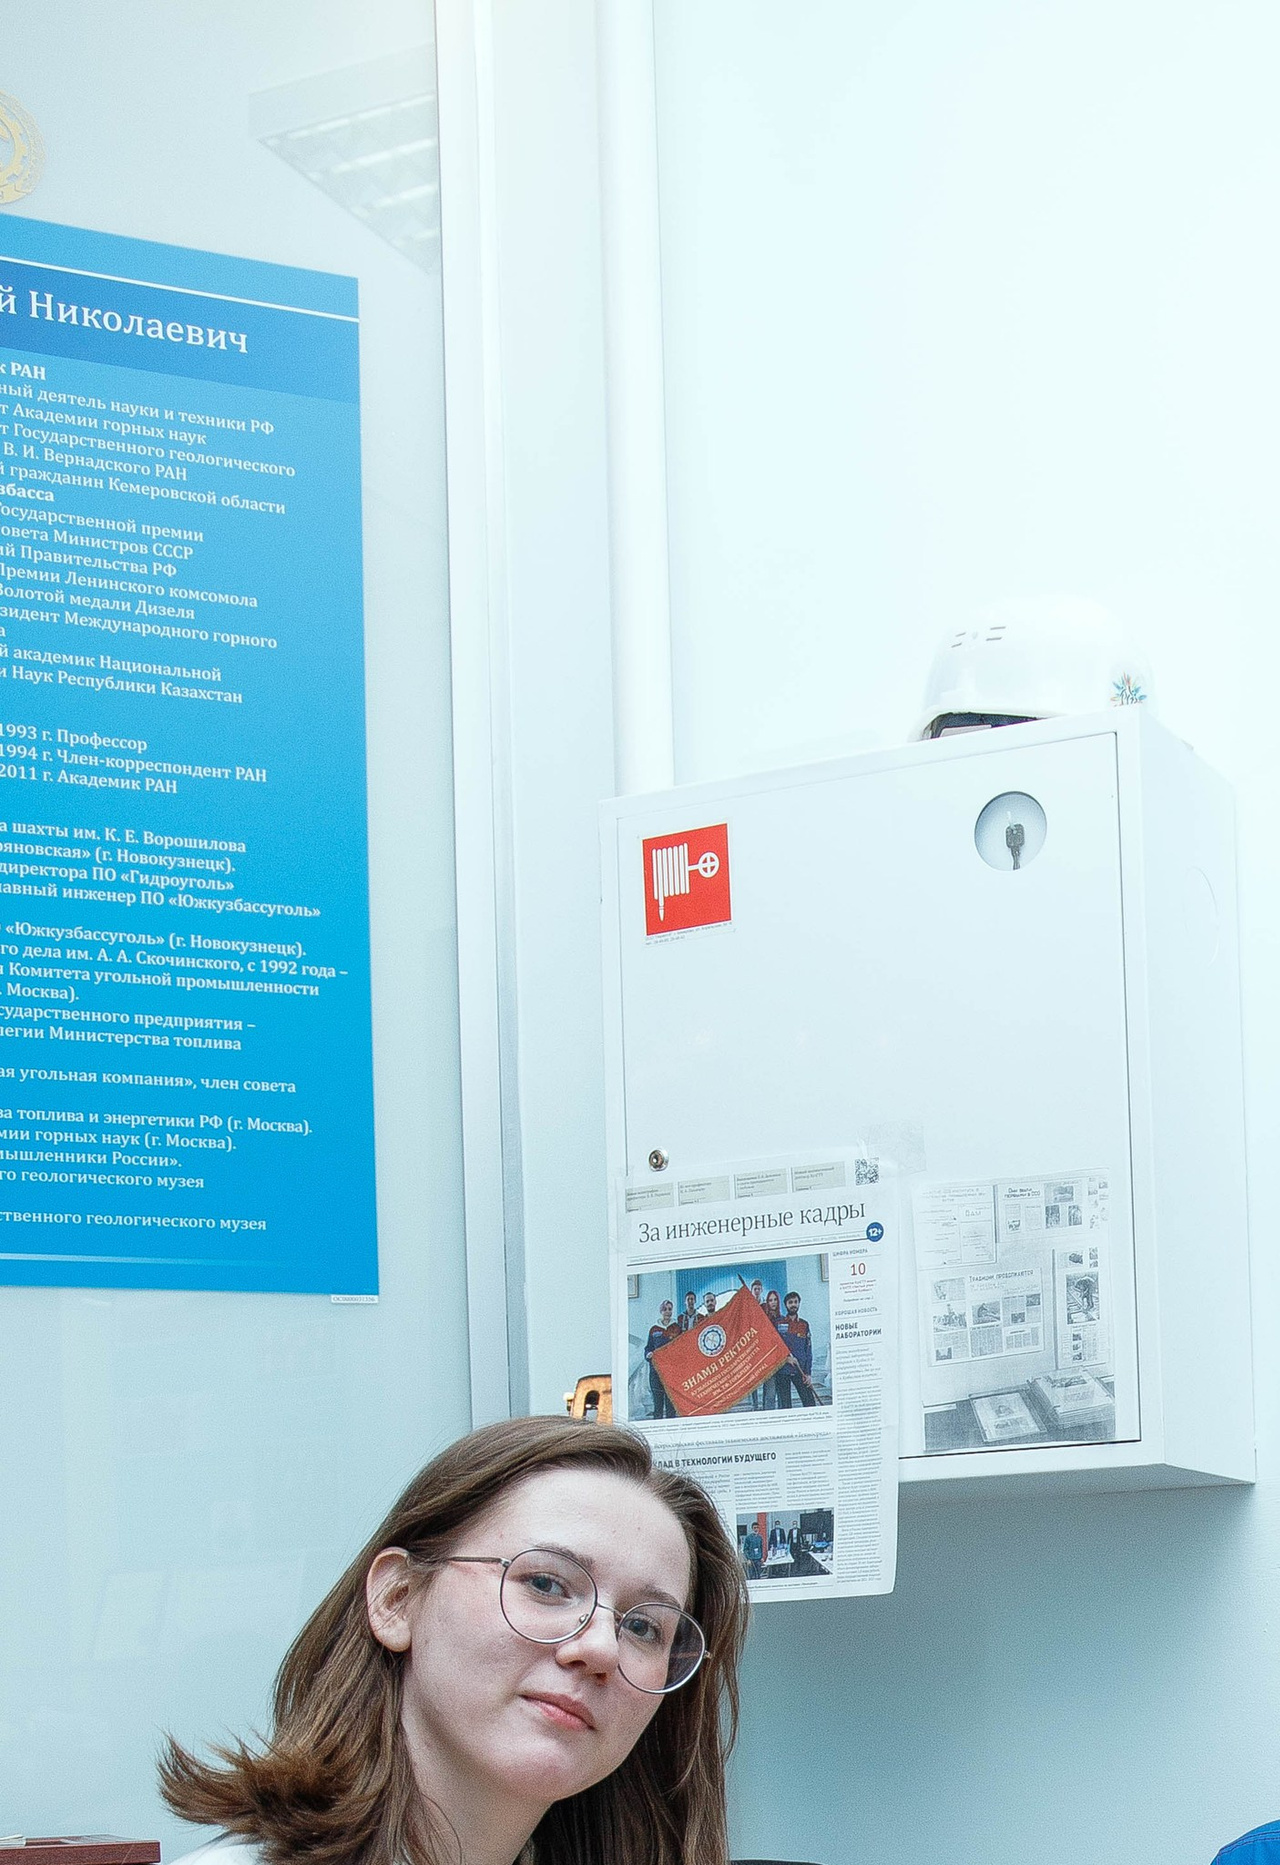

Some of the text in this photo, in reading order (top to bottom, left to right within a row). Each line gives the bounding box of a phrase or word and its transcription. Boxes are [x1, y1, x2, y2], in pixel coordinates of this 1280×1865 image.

[28, 289, 248, 354] Николаевич
[9, 360, 46, 381] РАН
[12, 402, 207, 446] Академии горных наук
[36, 389, 275, 436] деятель науки и техники РФ
[2, 440, 187, 481] В. И. Вернадского РАН
[13, 422, 296, 478] Государственного геологического
[9, 465, 104, 490] гражданин
[108, 476, 217, 505] Кемеровской
[219, 493, 286, 515] области
[0, 501, 204, 543] осударственной премии
[53, 528, 194, 560] Министров СССР
[20, 544, 178, 578] Правительства РФ
[63, 570, 166, 596] Ленинского
[168, 586, 259, 609] комсомола
[69, 594, 132, 612] медали
[134, 599, 195, 620] Дизеля
[63, 610, 210, 641] Международного
[212, 630, 278, 649] горного
[12, 647, 222, 682] академик Национальной
[11, 664, 243, 705] Наук Республики Казахстан
[40, 727, 148, 754] г. Профессор
[41, 748, 268, 783] г. Член-корреспондент РАН
[41, 768, 178, 795] г. Академик РАН
[11, 821, 247, 854] шахты им. К. Е. Ворошилова
[94, 845, 113, 864] (г.
[116, 847, 236, 875] Новокузнецк).
[91, 865, 117, 882] ПО
[119, 868, 235, 891] «Гидроуголь»
[0, 882, 322, 918] авный инженер ПО «Южкузбассуголь»
[4, 920, 307, 959] «Южкузбассуголь» (г. Новокузнецк).
[21, 945, 337, 979] дела им. А. А. Скочинского, с 1992 года
[6, 981, 80, 1003] Москва).
[8, 961, 91, 981] Комитета
[93, 970, 172, 987] угольной
[175, 976, 320, 997] промышленности
[133, 1012, 244, 1031] предприятия
[0, 1025, 243, 1051] егии Министерства топлива
[18, 1067, 297, 1094] угольная компания», член совета
[15, 1108, 313, 1137] топлива и энергетики РФ (г. Москва).
[34, 1130, 237, 1153] горных наук (г. Москва).
[0, 1149, 182, 1167] ышленники России».
[20, 1170, 205, 1191] геологического музея
[85, 1213, 217, 1229] геологического
[218, 1218, 267, 1233] музея
[638, 1202, 866, 1244] За инженерные кадры
[868, 1226, 883, 1237] 12+
[850, 1262, 866, 1276] 10
[835, 1322, 858, 1331] НОВЫЕ
[835, 1328, 882, 1340] ЛАБОРАТОРИИ
[681, 1362, 718, 1391] ЗНАМЯ
[718, 1327, 758, 1366] РЕКТОРА
[681, 1455, 733, 1467] ТЕХНОЛОГИИ
[734, 1452, 777, 1464] БУДУЩЕГО
